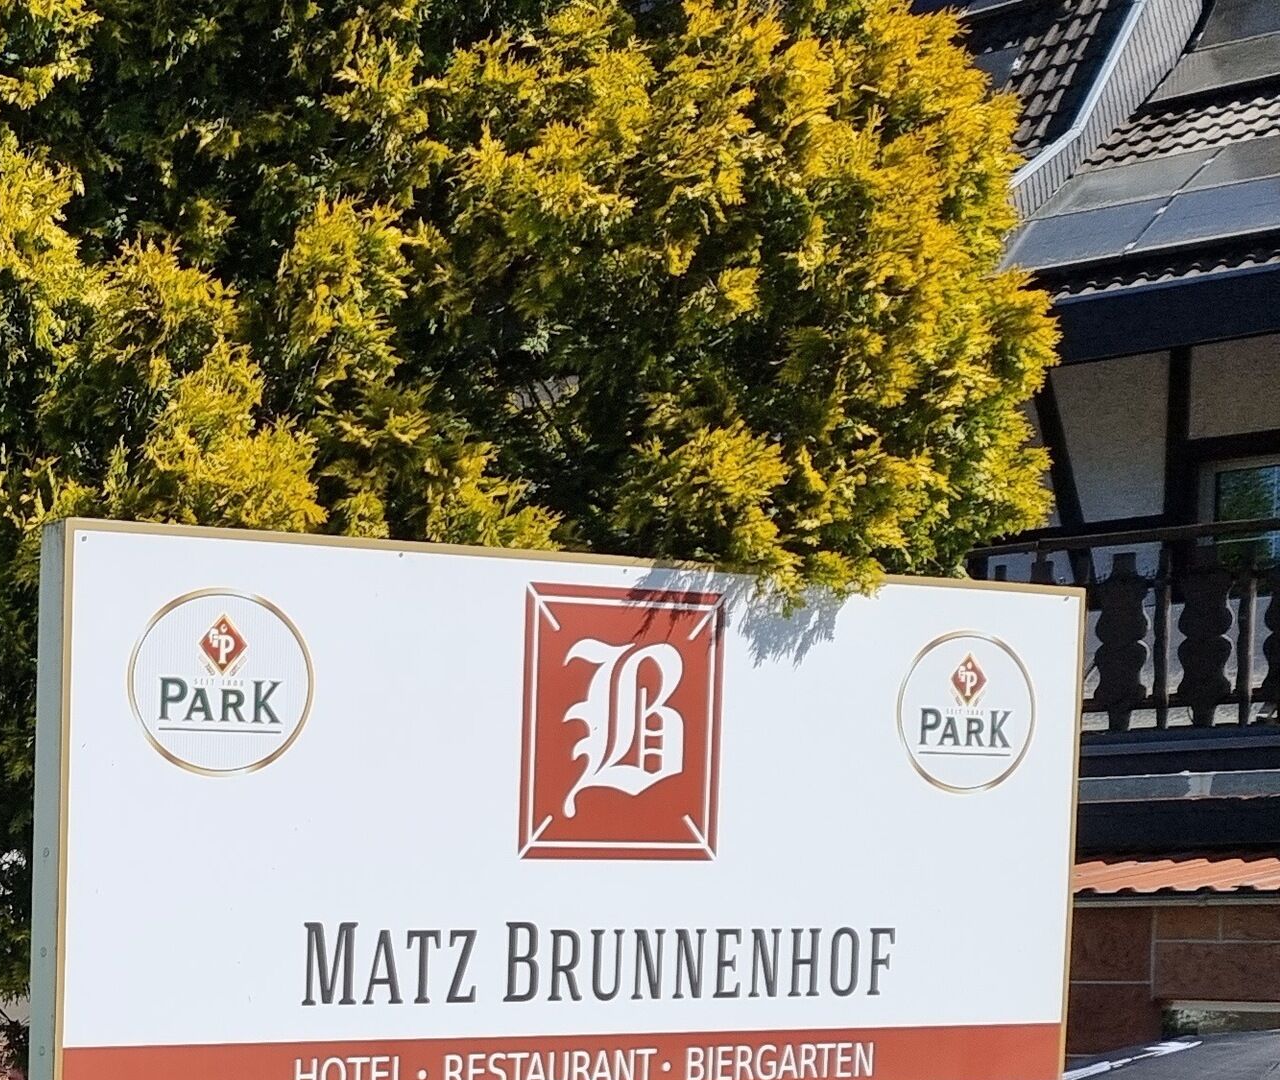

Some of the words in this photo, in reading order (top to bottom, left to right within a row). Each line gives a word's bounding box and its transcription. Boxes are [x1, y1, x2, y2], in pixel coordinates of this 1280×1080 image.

[157, 676, 284, 724] PARK
[917, 707, 1013, 749] PARK
[301, 921, 478, 1006] MATZ
[502, 921, 896, 1002] BRUNNENHOF
